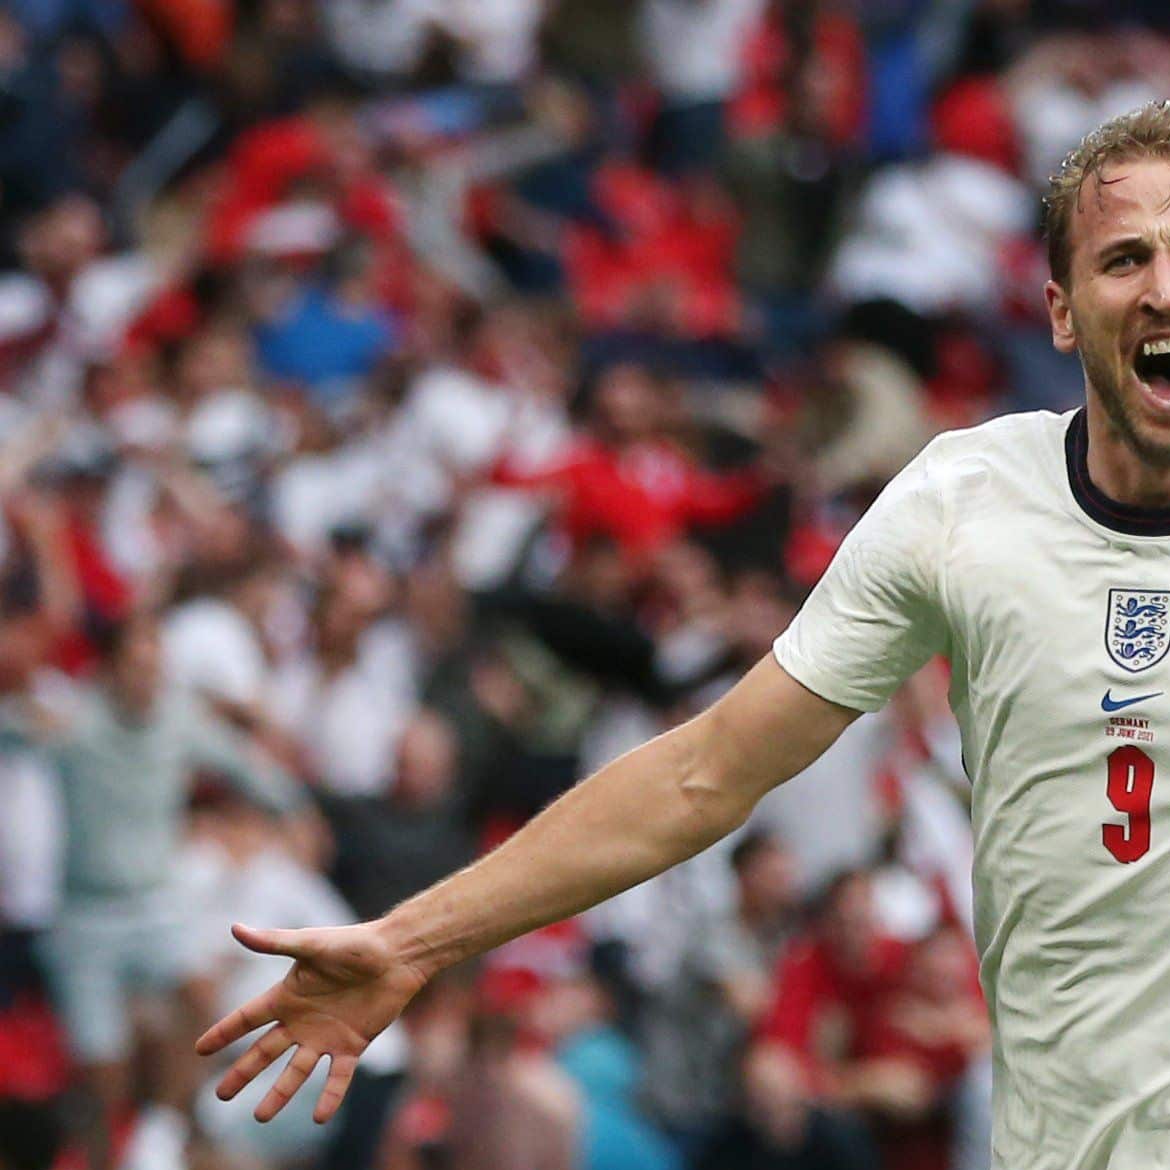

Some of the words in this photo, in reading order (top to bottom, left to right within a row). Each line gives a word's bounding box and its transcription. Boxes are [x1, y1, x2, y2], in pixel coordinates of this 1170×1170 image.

[1109, 717, 1149, 728] GERMANY
[1117, 728, 1135, 738] JUNE
[1102, 744, 1155, 863] 9
